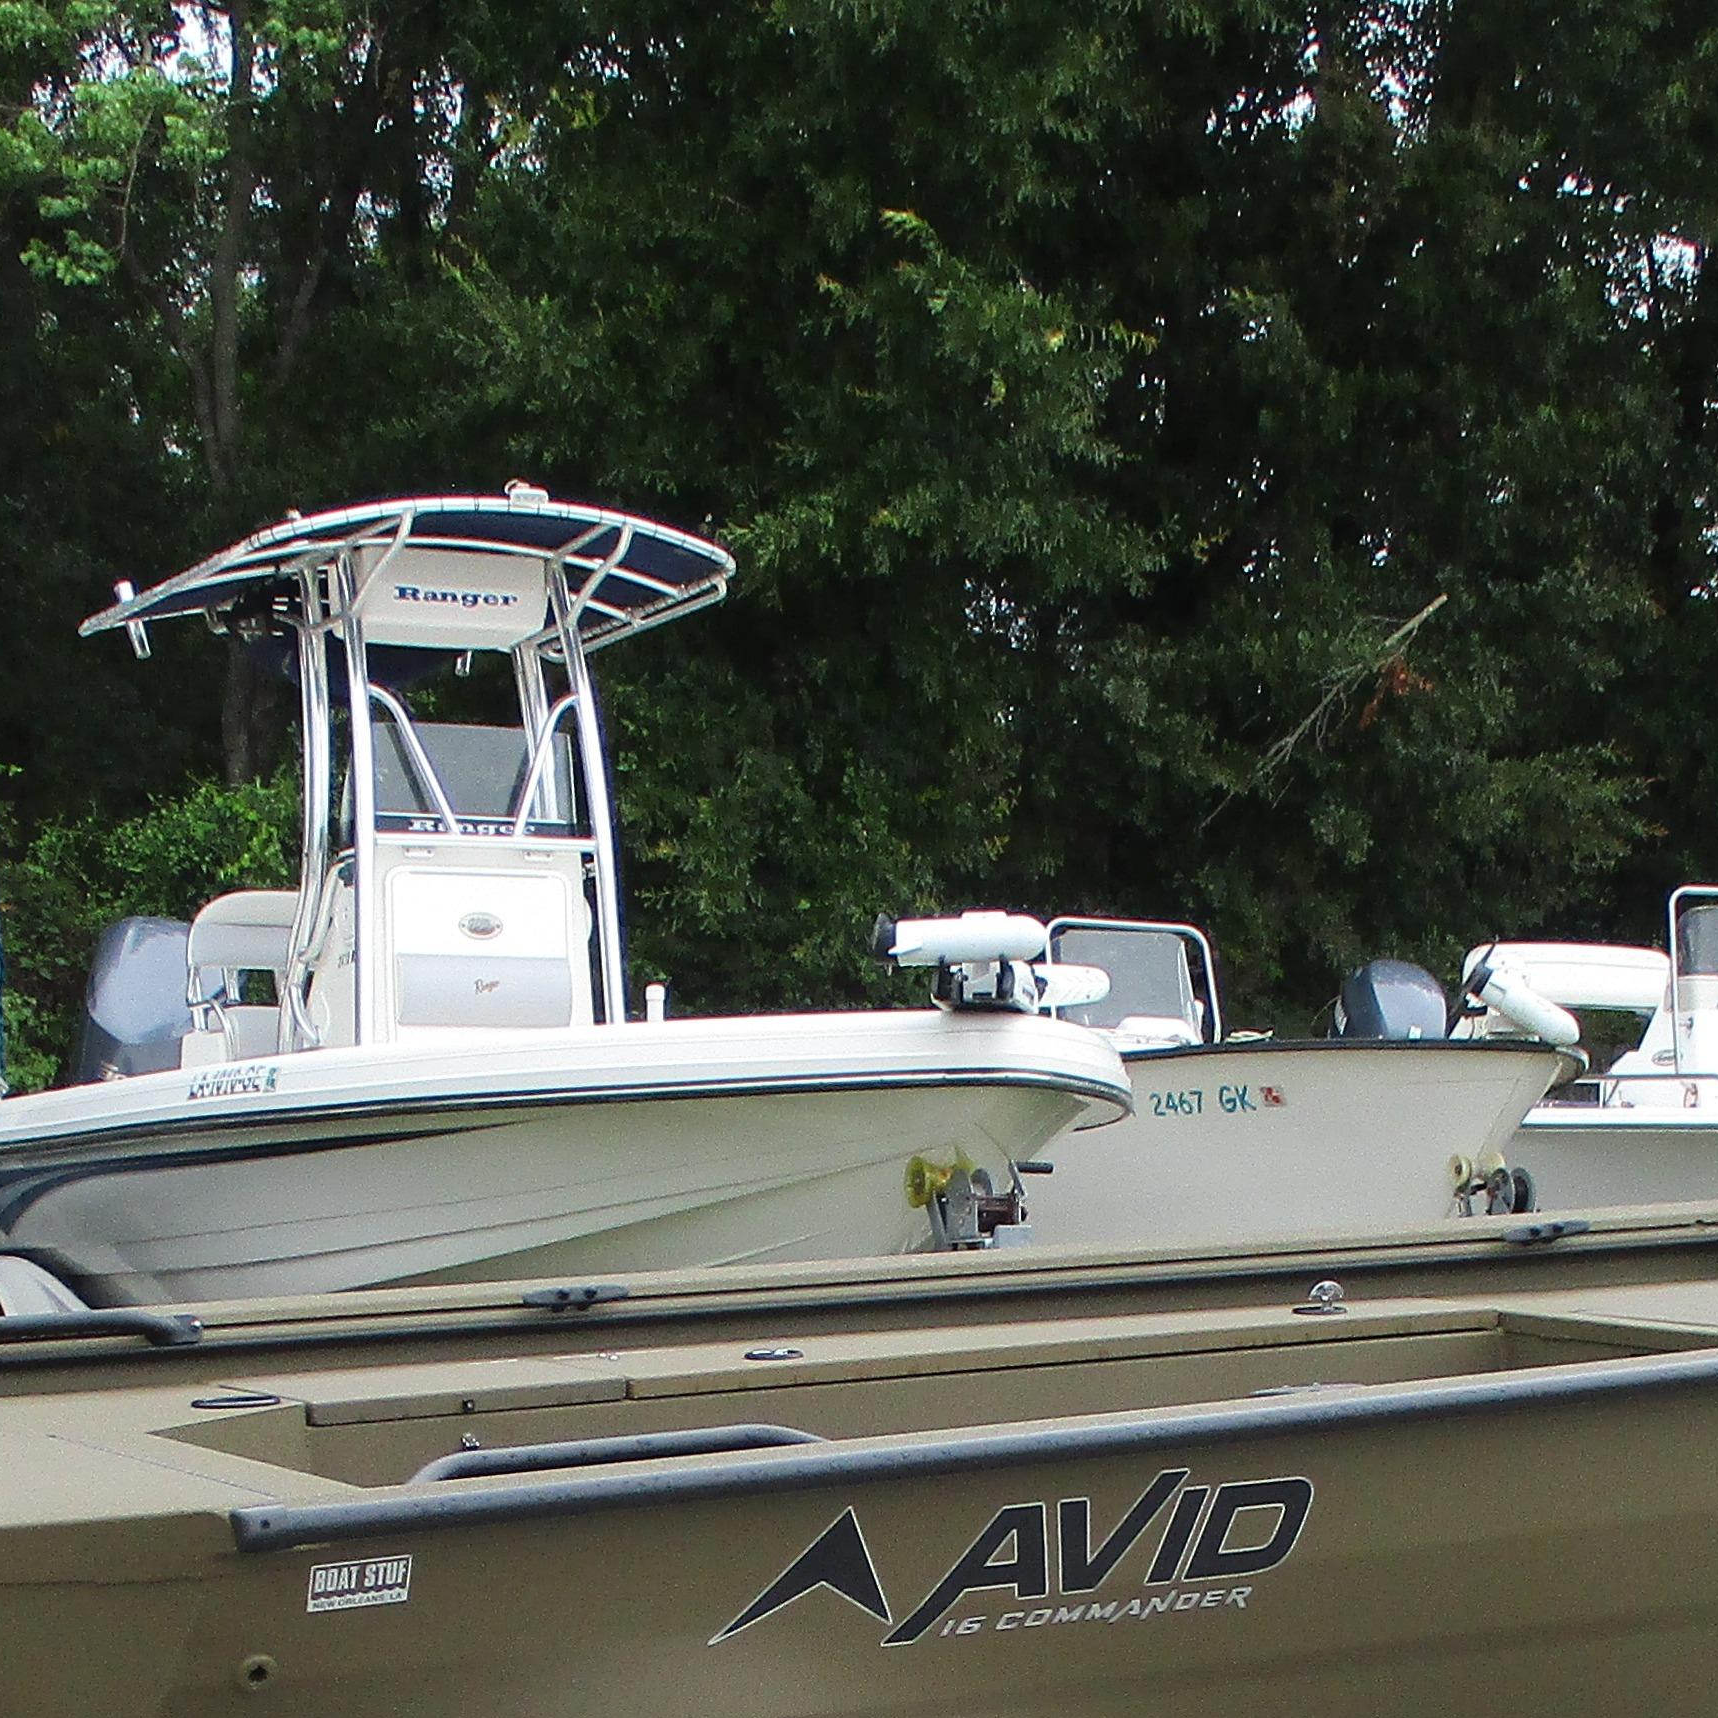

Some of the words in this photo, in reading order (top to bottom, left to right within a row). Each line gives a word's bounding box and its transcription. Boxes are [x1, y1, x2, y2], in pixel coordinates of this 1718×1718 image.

[394, 585, 519, 609] Ranger
[1149, 1090, 1203, 1117] 2467
[1218, 1084, 1257, 1113] GK
[881, 1468, 1315, 1647] AVID
[314, 1566, 360, 1594] BOAT
[364, 1560, 407, 1588] STUF
[313, 1601, 337, 1610] NEW
[939, 1616, 986, 1638] 16
[995, 1586, 1253, 1625] COMMANDER
